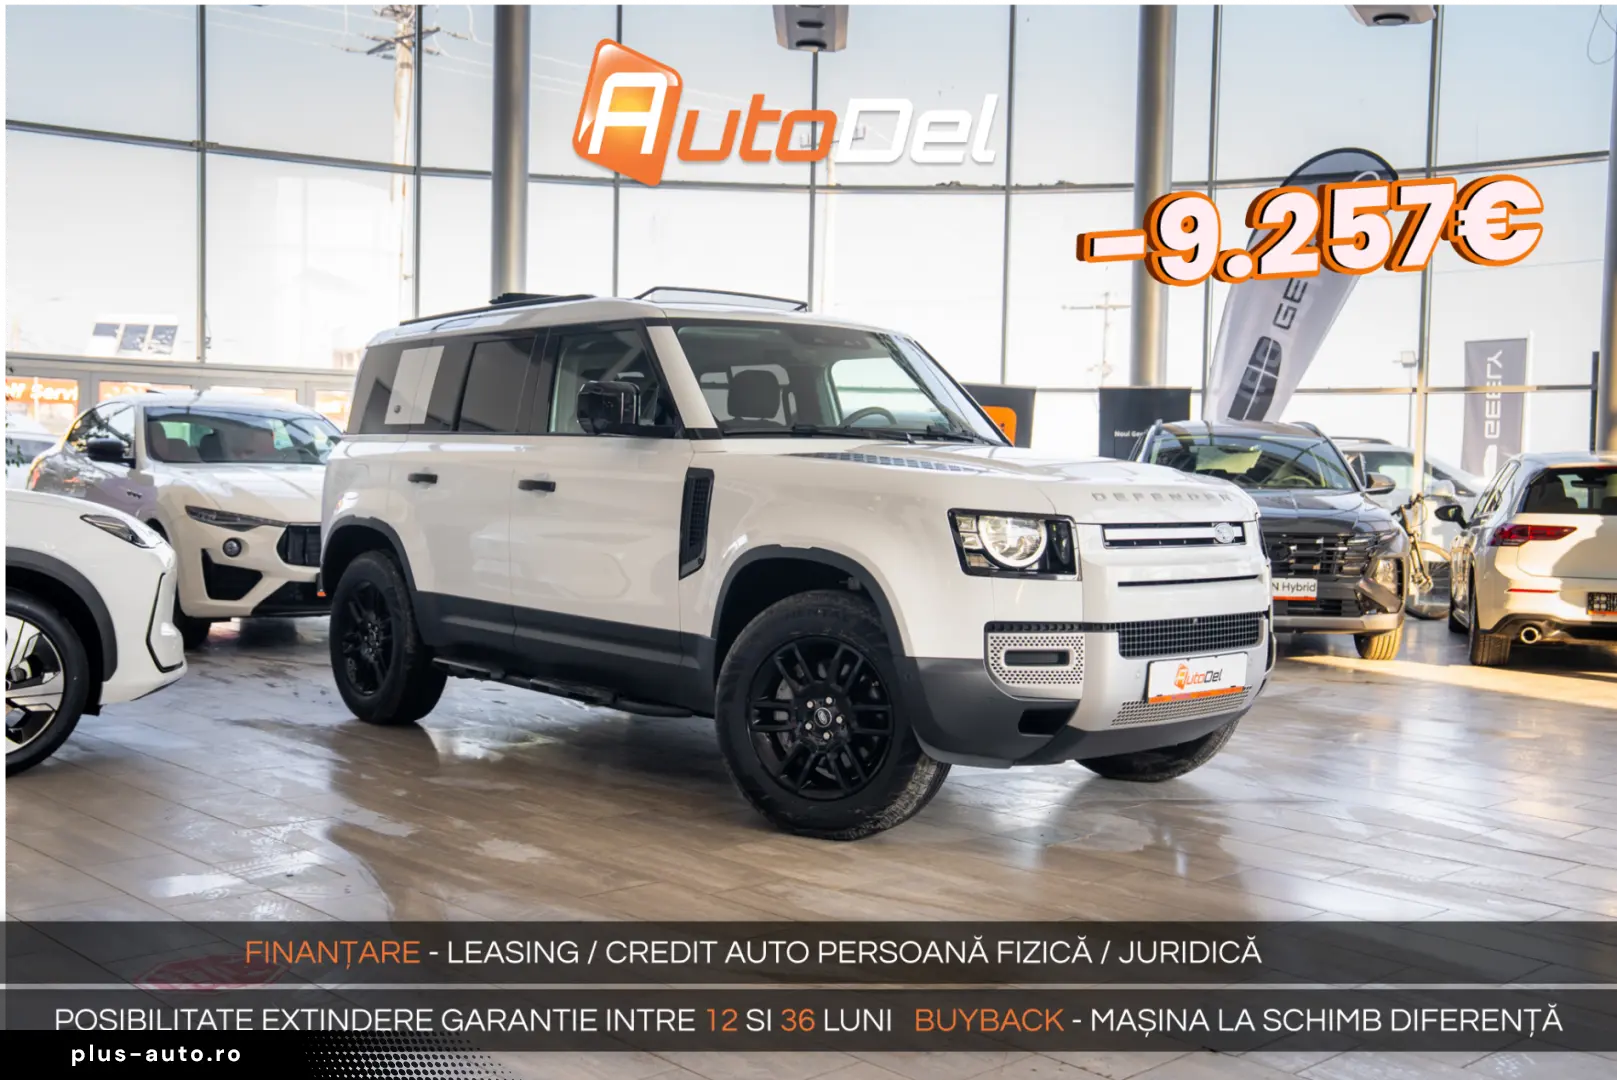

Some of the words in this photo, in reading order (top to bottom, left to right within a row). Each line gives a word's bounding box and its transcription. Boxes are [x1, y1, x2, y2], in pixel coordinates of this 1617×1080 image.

[1091, 491, 1233, 502] DEFENDER
[1282, 581, 1316, 593] Hybrid
[1175, 666, 1224, 687] AutoDel
